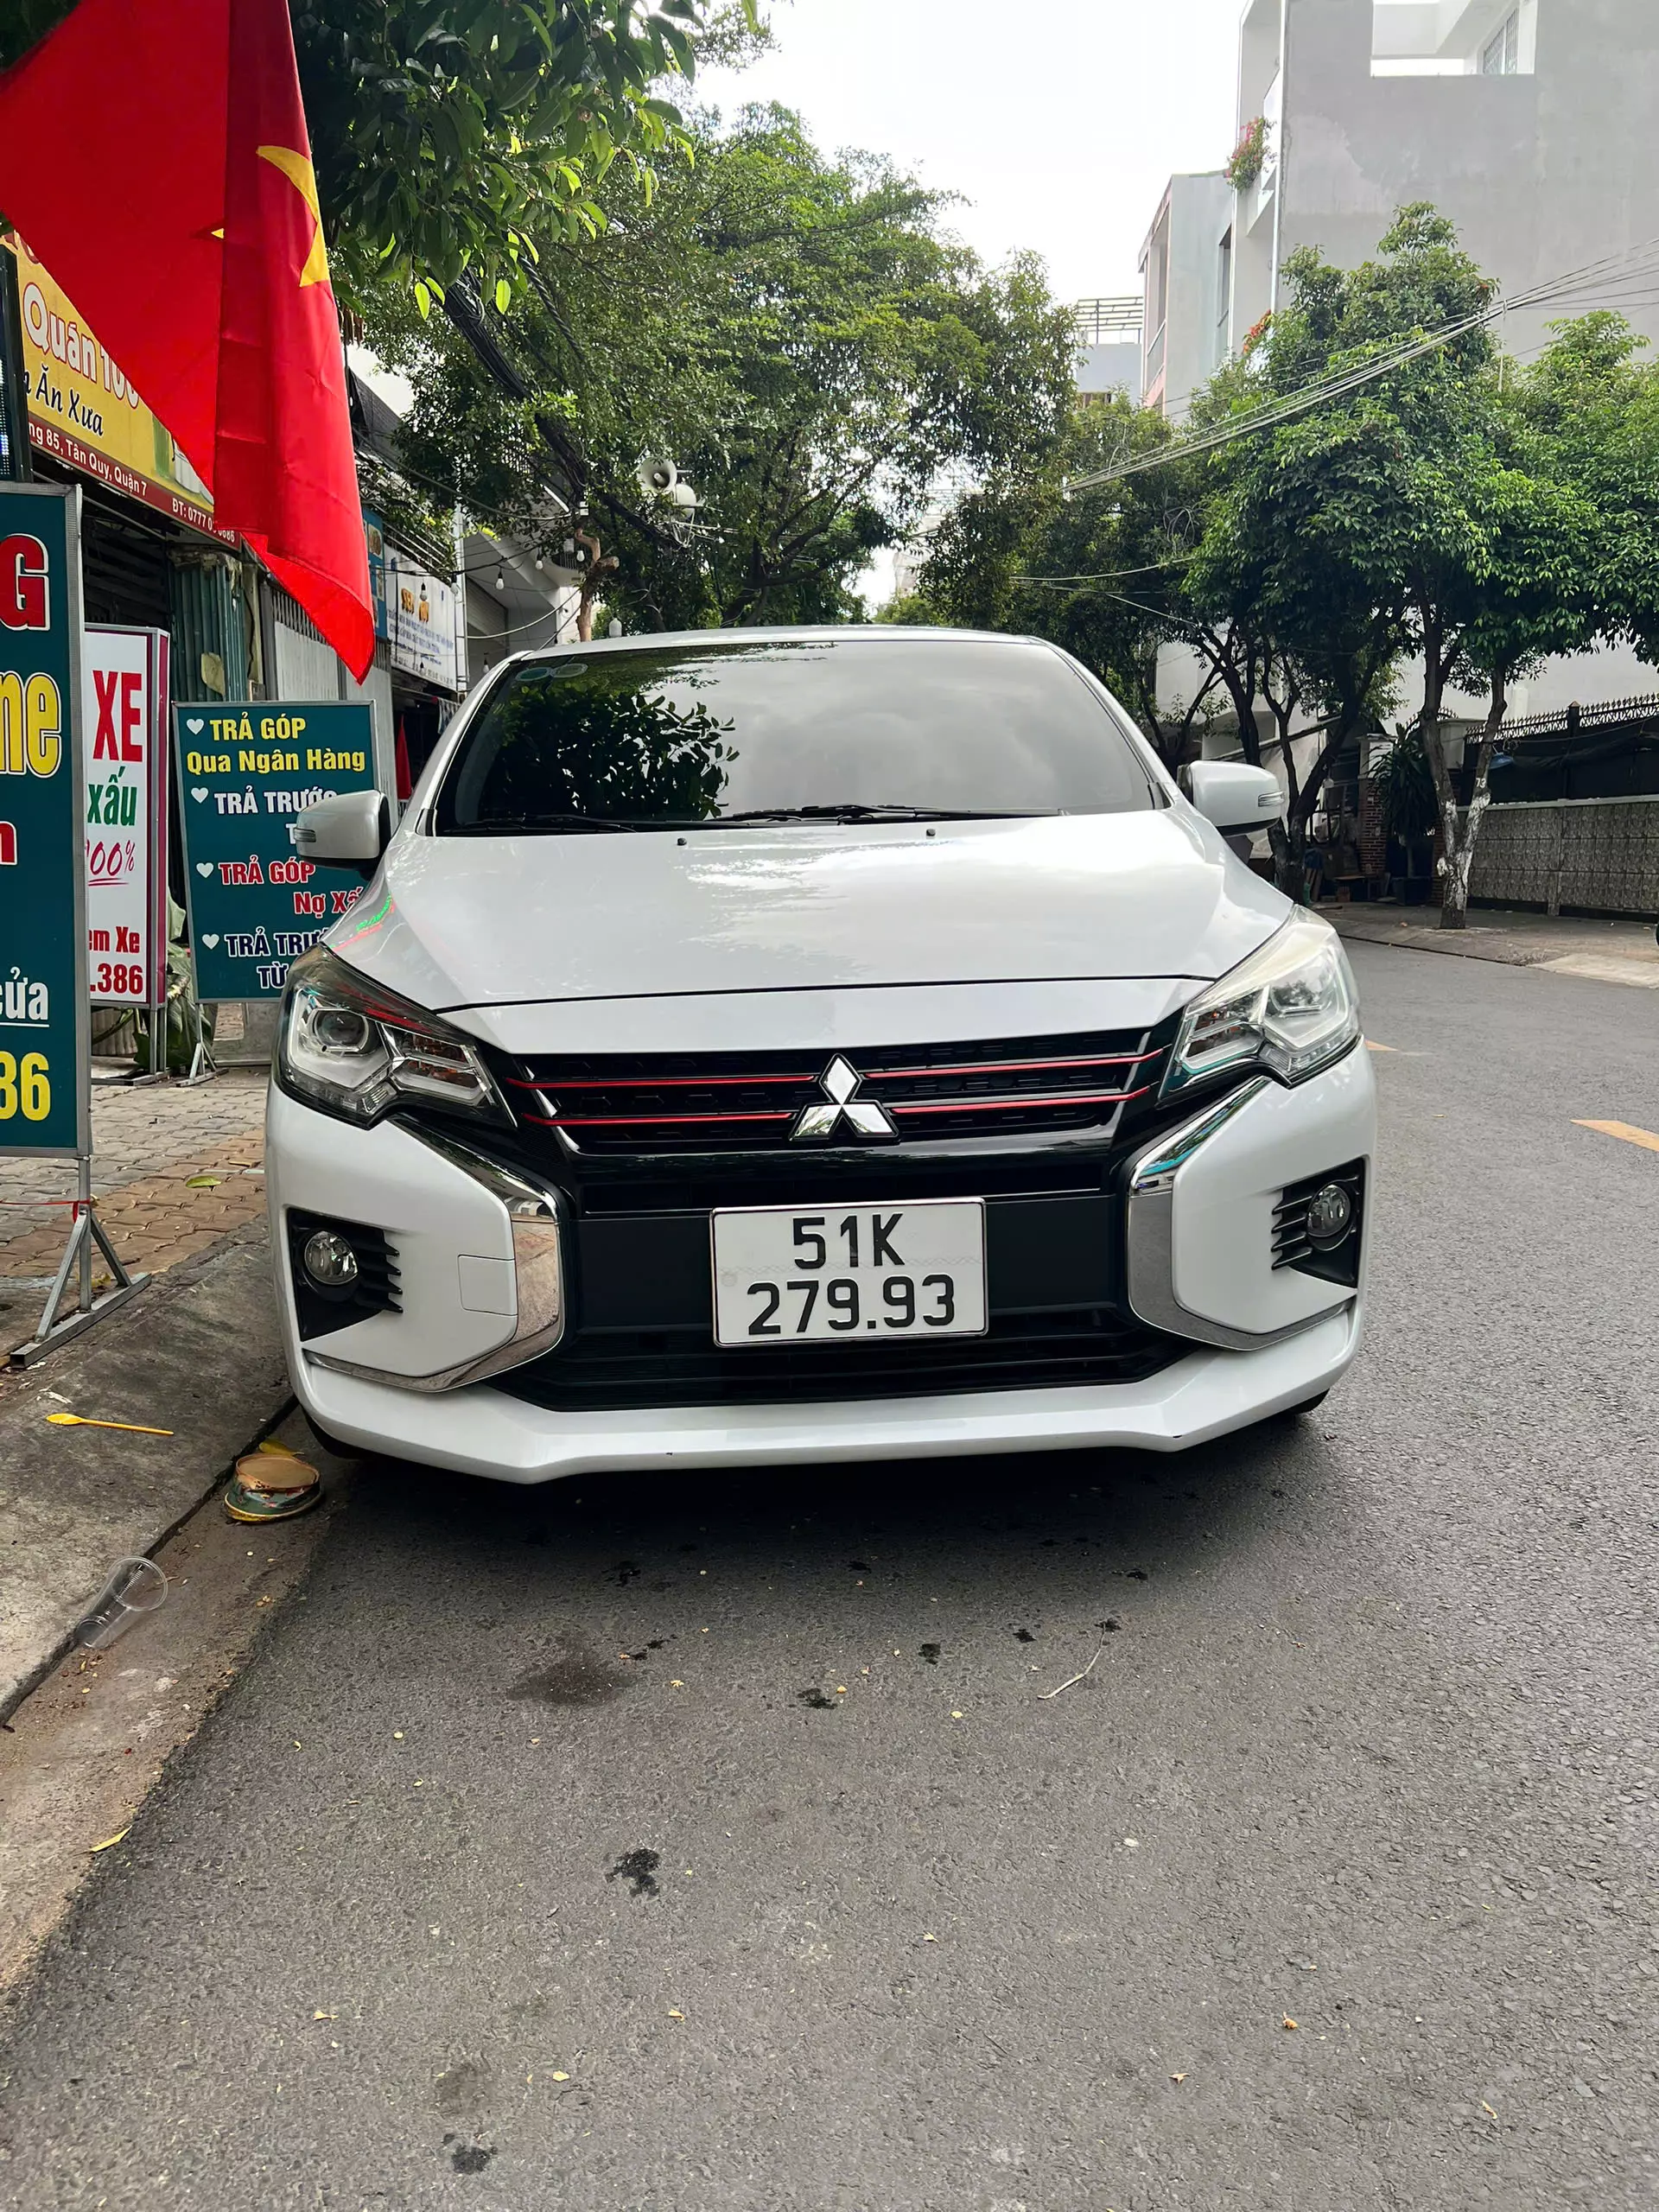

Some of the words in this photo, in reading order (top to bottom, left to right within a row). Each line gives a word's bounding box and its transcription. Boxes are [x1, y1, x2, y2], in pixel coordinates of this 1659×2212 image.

[22, 282, 98, 384] Quán
[35, 363, 63, 413] Ăn
[68, 388, 104, 437] Xưa
[47, 429, 64, 454] 85,
[66, 438, 86, 465] Tân
[89, 452, 112, 480] Quy,
[114, 467, 140, 494] Quận
[142, 480, 147, 497] 7
[172, 497, 187, 518] ĐT:
[188, 506, 207, 528] 0777
[92, 670, 143, 762] XE
[209, 712, 254, 741] TRẢ
[260, 713, 306, 741] GÓP
[187, 751, 231, 774] Qua
[238, 749, 299, 774] Ngân
[307, 748, 365, 772] Hàng
[87, 766, 138, 827] xấu
[214, 785, 259, 815] TRẢ
[218, 854, 264, 886] TRẢ
[269, 856, 316, 884] GÓP
[294, 891, 326, 918] Nợ
[116, 926, 140, 954] Xe
[226, 926, 271, 957] TRẢ
[791, 1212, 906, 1269] 51K
[747, 1273, 956, 1336] 279.93
